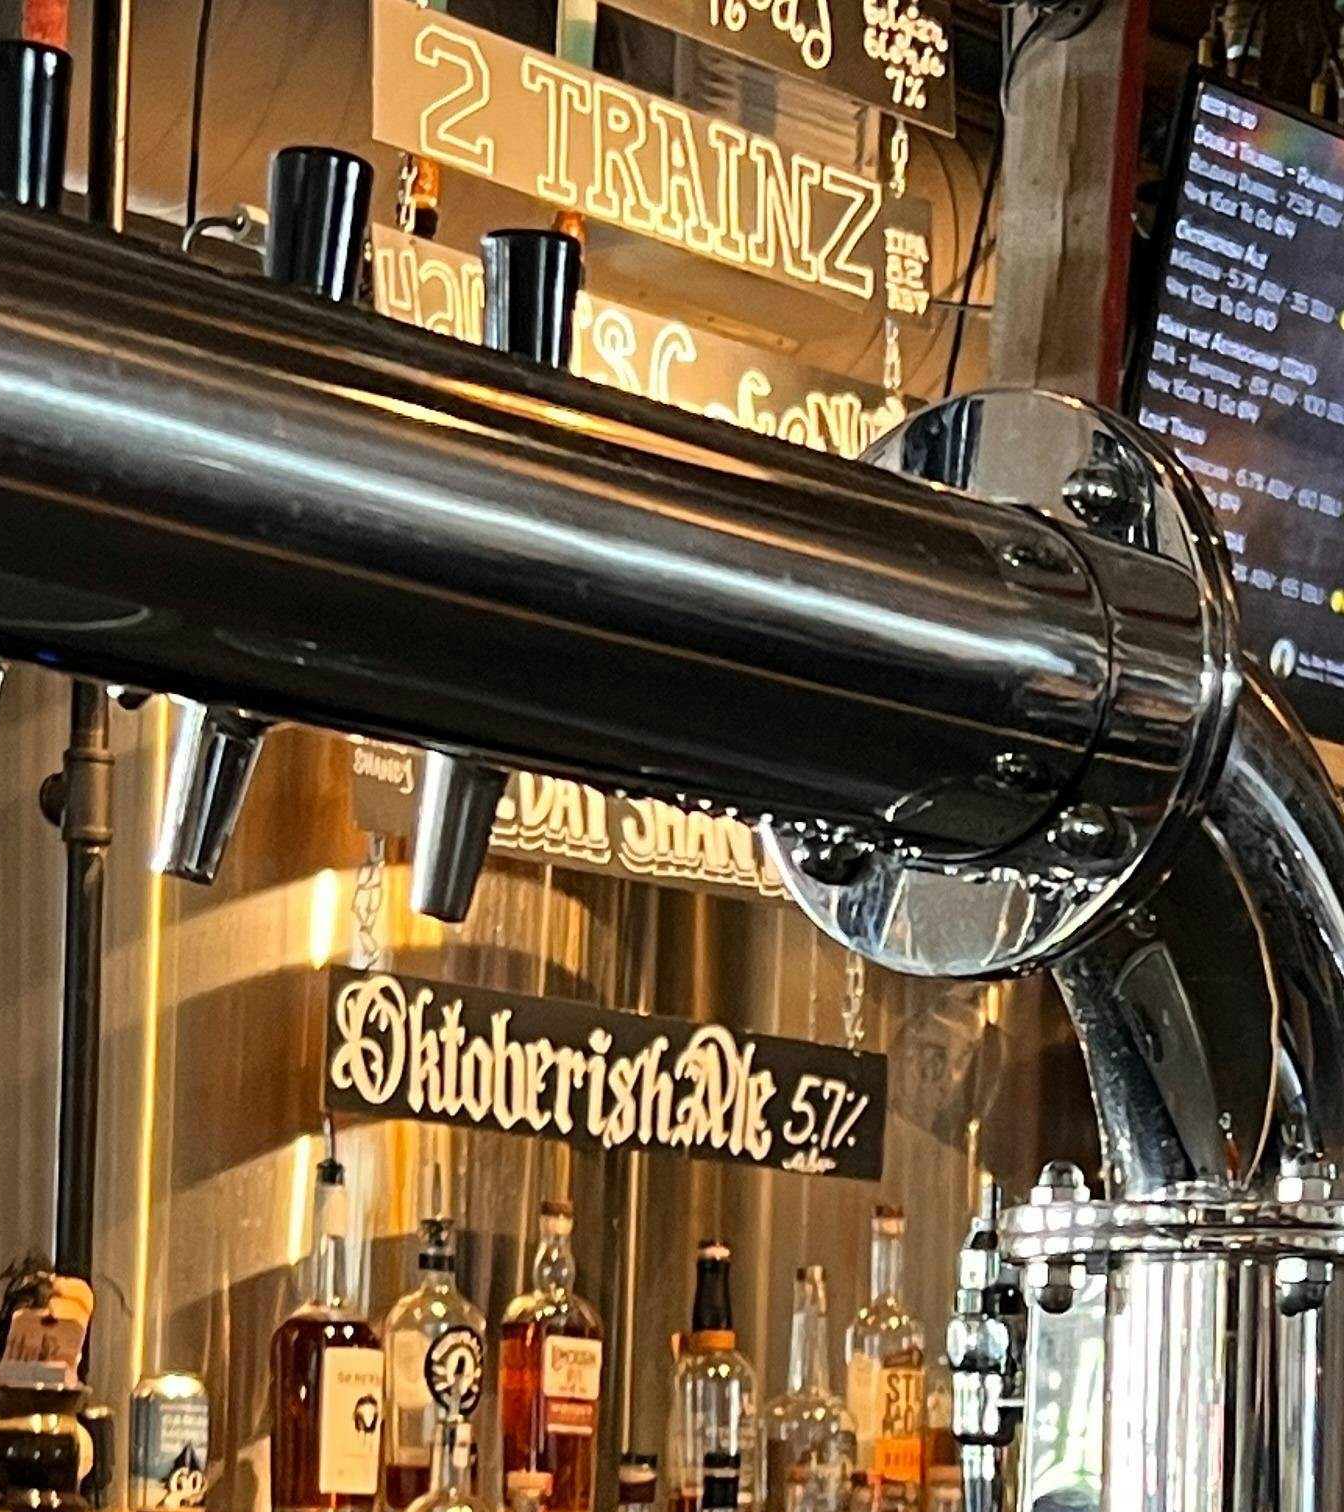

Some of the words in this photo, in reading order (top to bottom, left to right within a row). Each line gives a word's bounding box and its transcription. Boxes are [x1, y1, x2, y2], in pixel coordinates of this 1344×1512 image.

[413, 22, 495, 177] 2
[520, 55, 884, 301] TRAINZ
[783, 1076, 870, 1150] 5.7%
